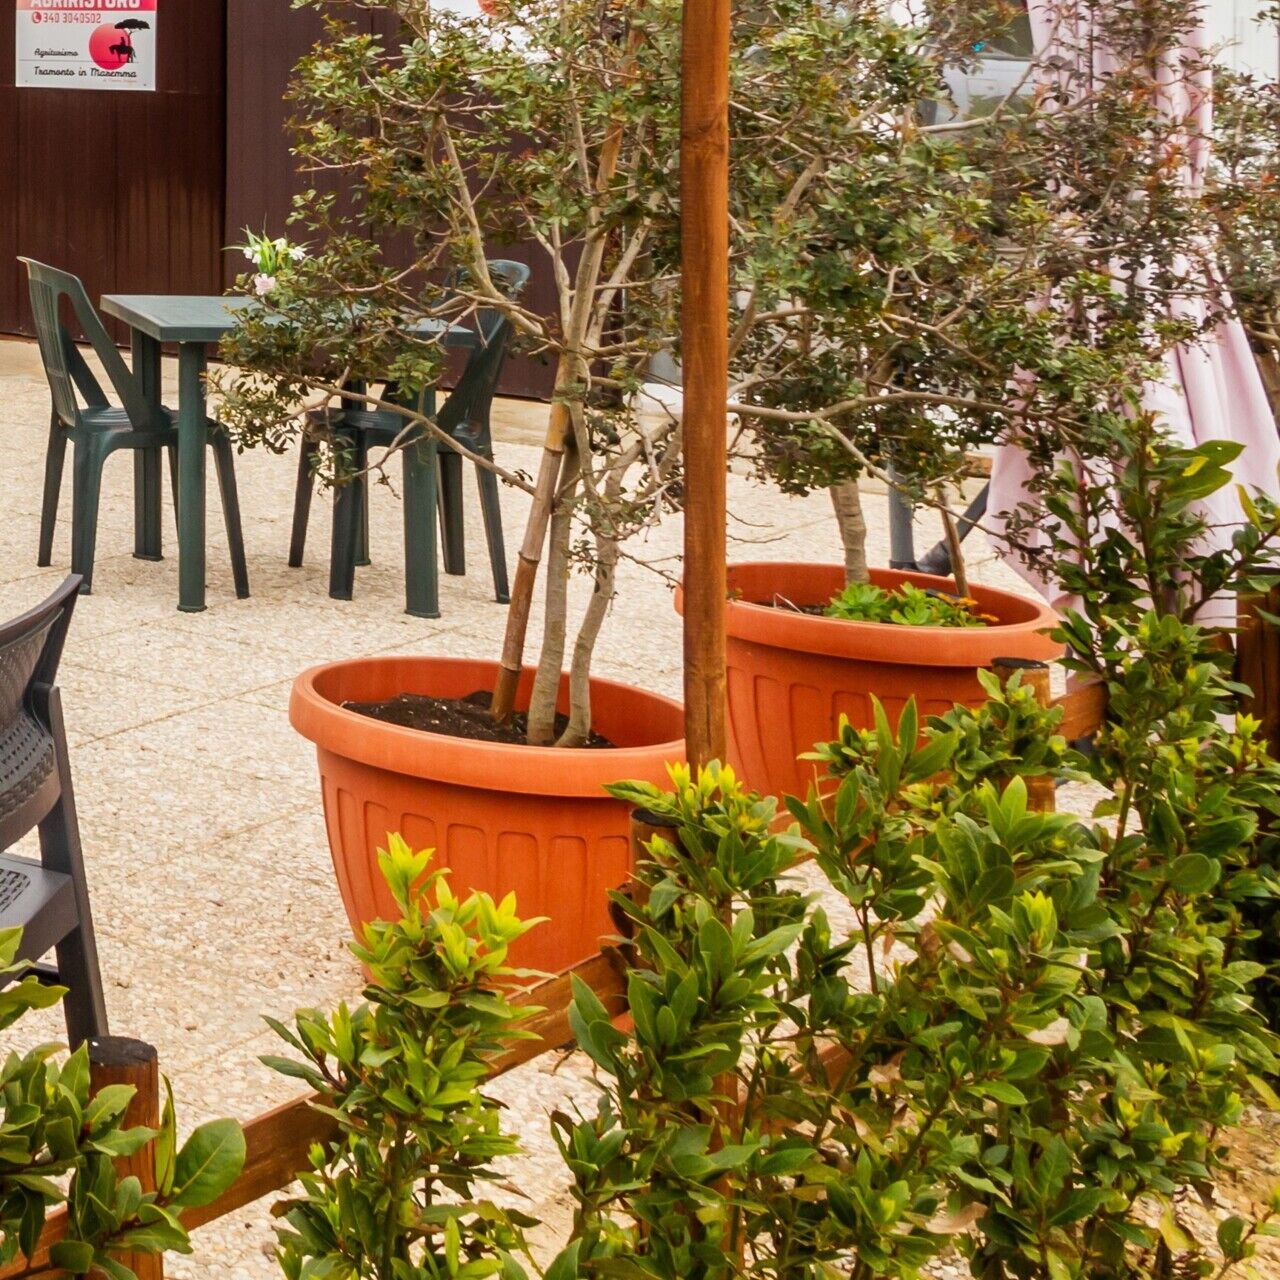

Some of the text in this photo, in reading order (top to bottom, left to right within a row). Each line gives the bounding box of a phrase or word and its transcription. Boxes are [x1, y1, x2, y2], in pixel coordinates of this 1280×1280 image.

[42, 12, 102, 24] 340 3040502
[34, 48, 79, 58] Agriturismo
[34, 65, 137, 78] Tramonto in Maremma
